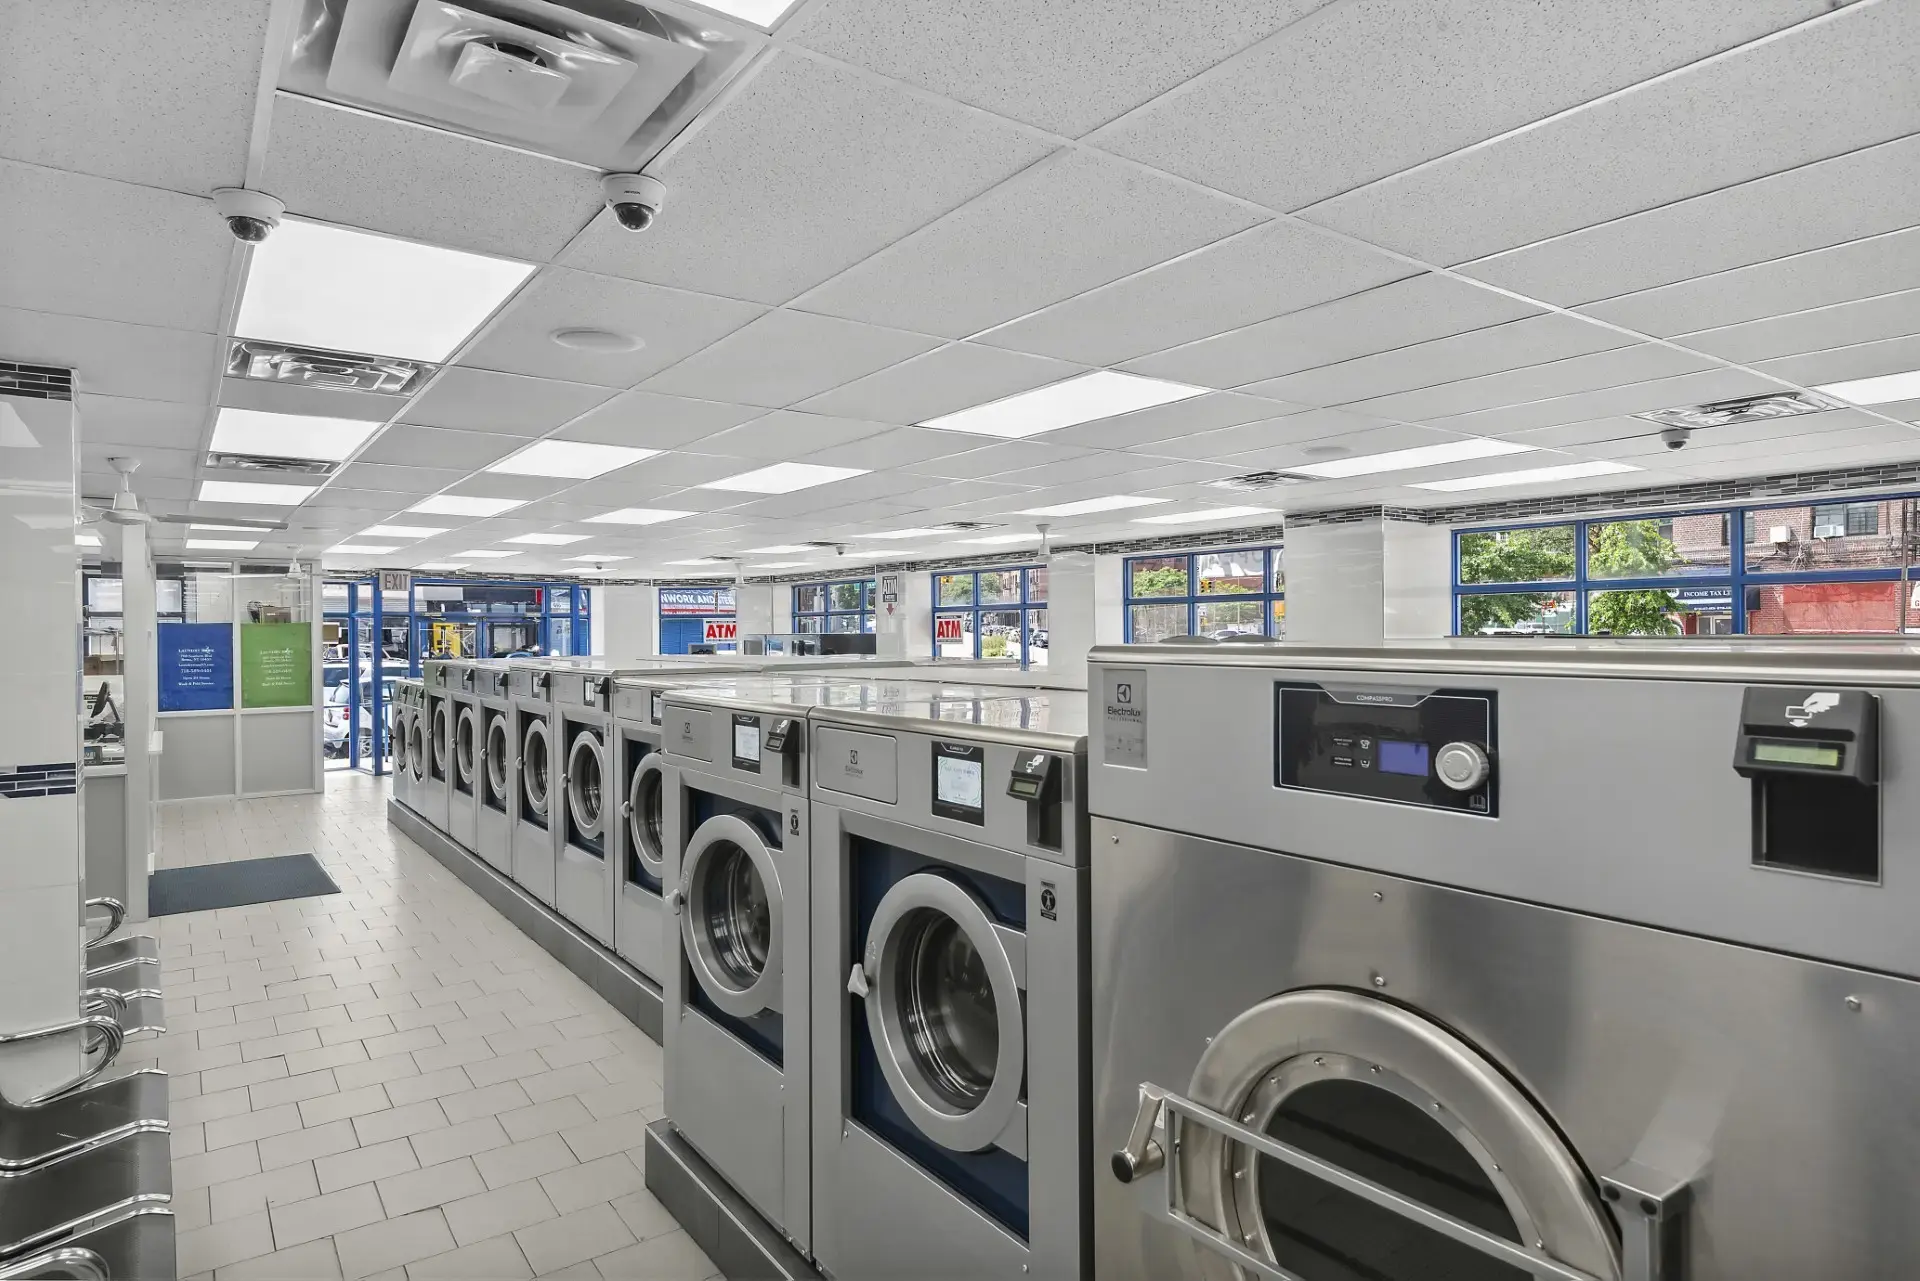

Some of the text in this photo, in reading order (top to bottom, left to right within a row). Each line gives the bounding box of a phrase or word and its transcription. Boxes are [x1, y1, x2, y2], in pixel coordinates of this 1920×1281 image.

[384, 573, 409, 590] EXIT
[697, 595, 715, 604] AND
[706, 624, 736, 639] ATM
[937, 620, 962, 638] ATM
[1356, 694, 1393, 702] COMPASSPRO
[1107, 705, 1141, 717] Electrolux
